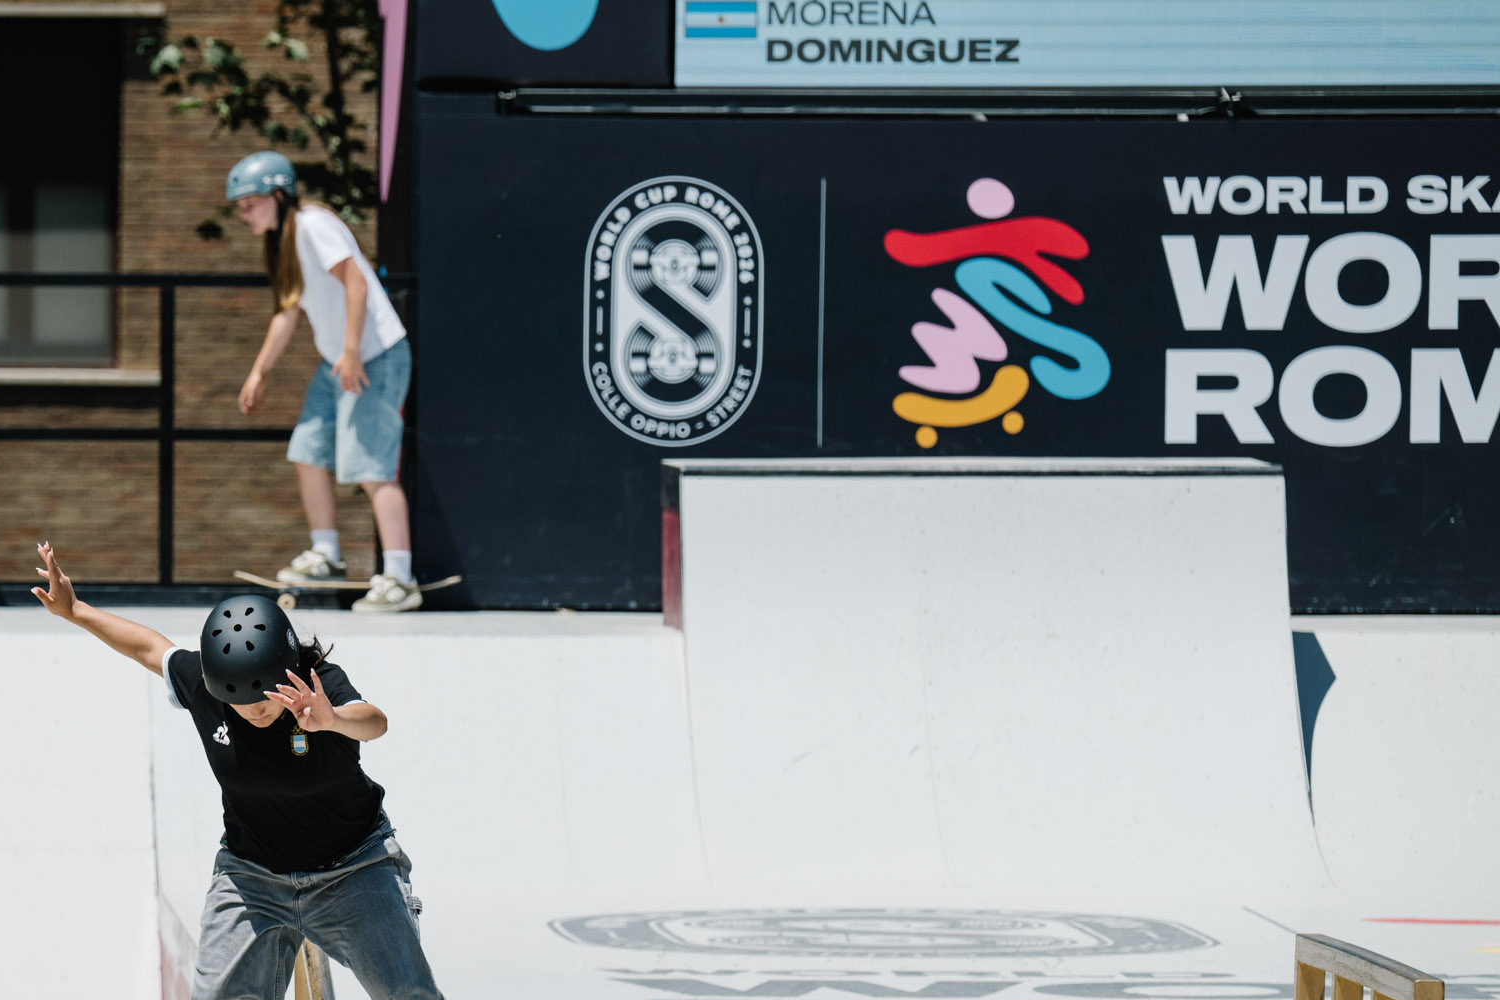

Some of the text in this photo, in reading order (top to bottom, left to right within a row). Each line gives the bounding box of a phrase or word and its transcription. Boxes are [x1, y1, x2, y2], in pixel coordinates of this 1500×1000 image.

[766, 0, 937, 26] MORENA
[766, 39, 1021, 63] DOMINGUEZ
[1162, 174, 1500, 214] WORLD SK
[594, 184, 756, 285] WORLD CUP ROME 2026
[1161, 231, 1500, 334] WOR
[591, 361, 631, 420] COLLE
[630, 415, 691, 439] OPPIO
[705, 364, 754, 428] STREET
[1164, 345, 1500, 448] ROM
